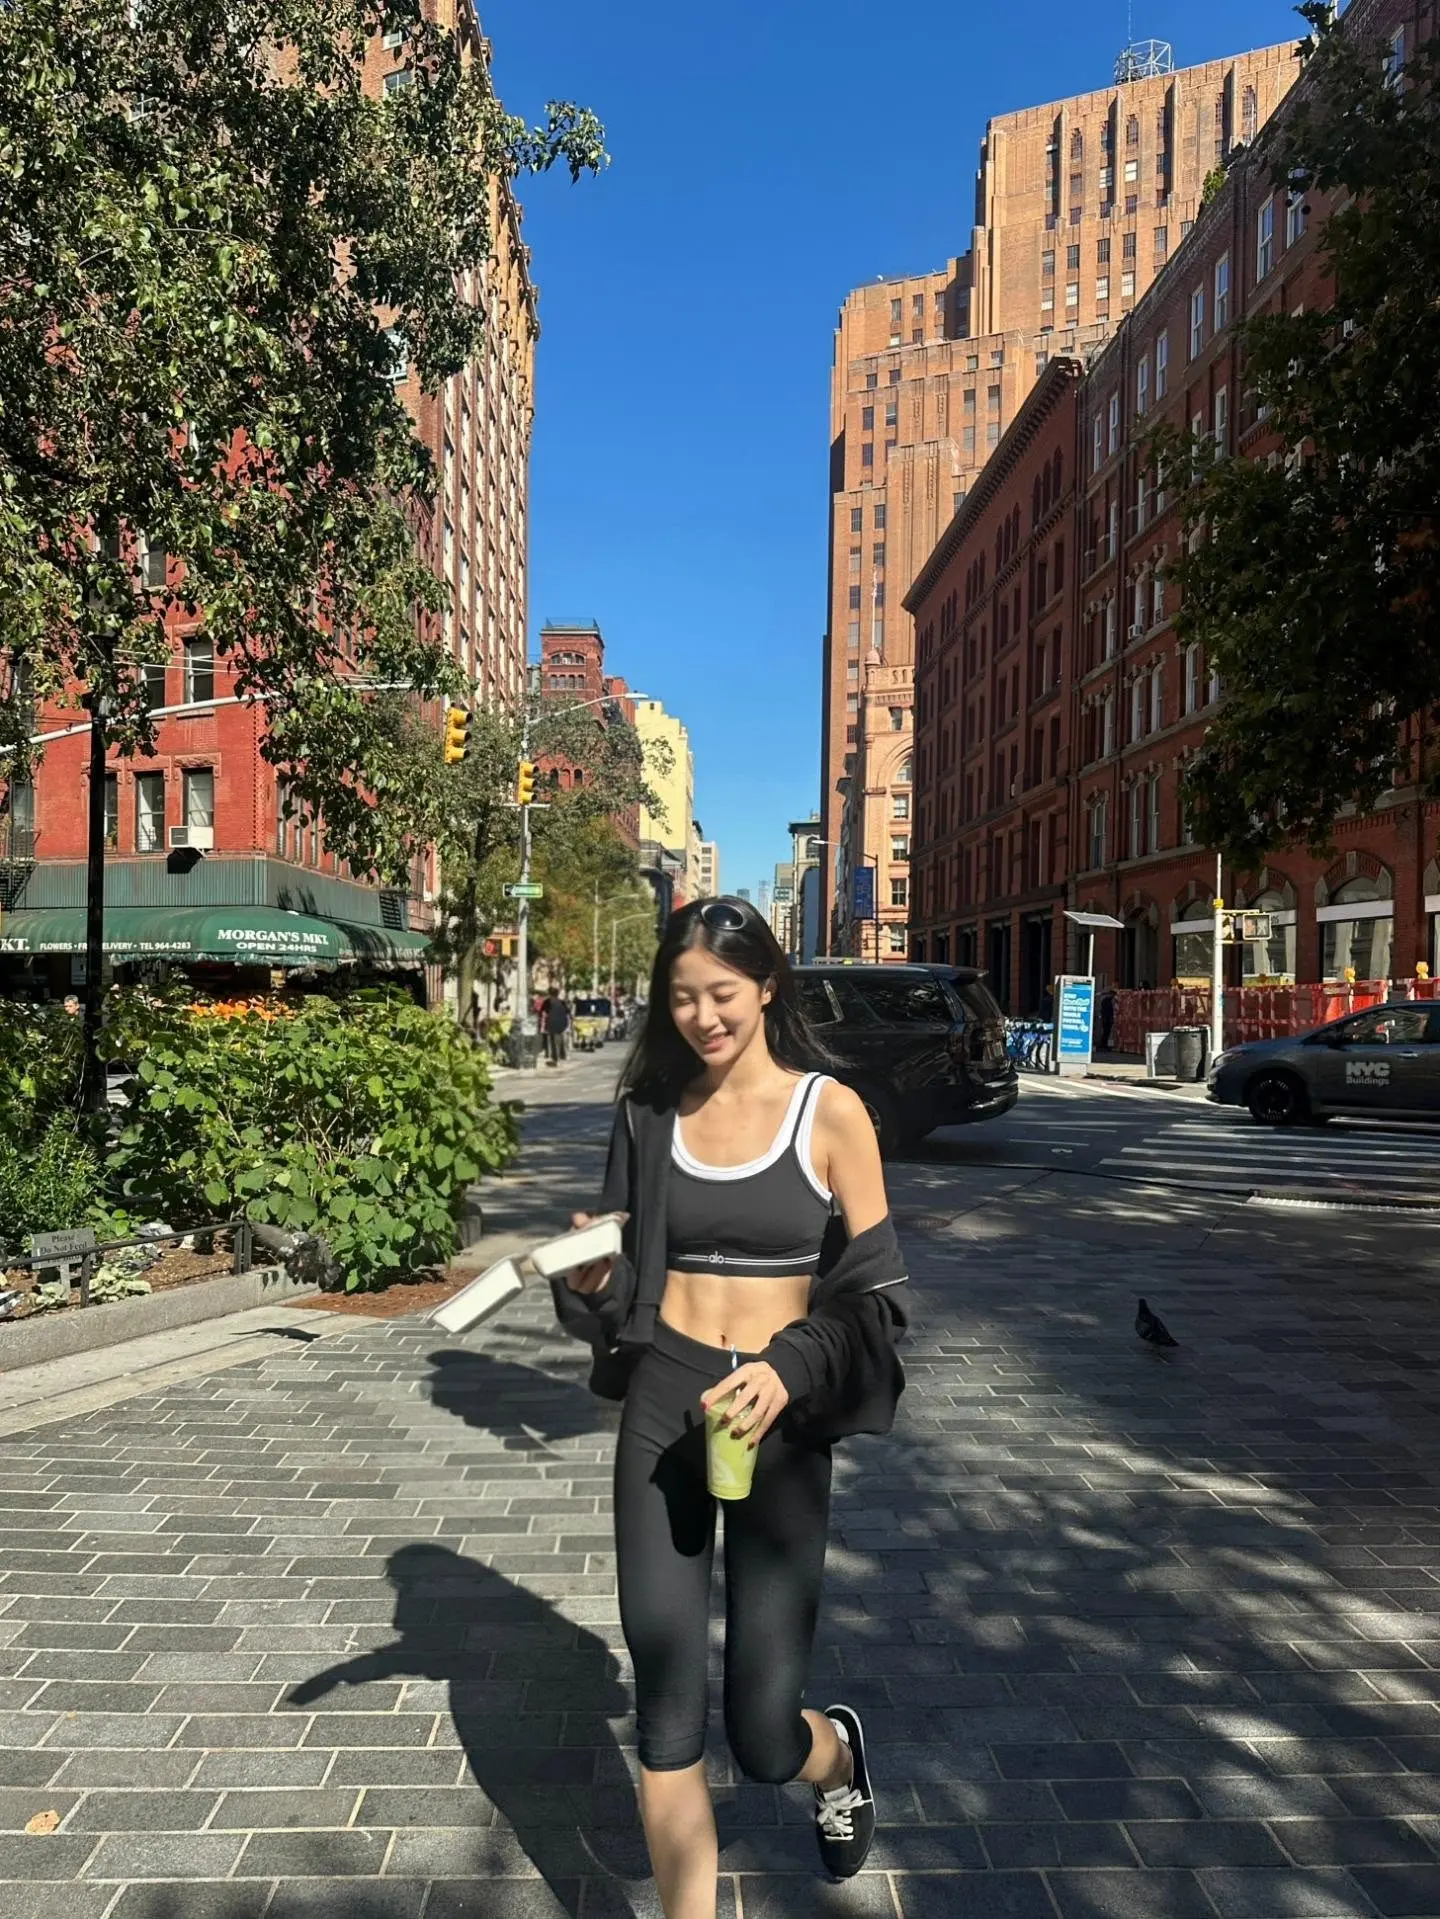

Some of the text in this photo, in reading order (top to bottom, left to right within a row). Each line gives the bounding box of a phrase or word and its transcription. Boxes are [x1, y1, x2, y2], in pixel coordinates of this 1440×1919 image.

[217, 929, 300, 942] MORGAN'S
[0, 938, 30, 951] KT.
[40, 942, 72, 950] FLOWERS
[102, 942, 132, 950] ELIVERY
[140, 942, 154, 950] TEL
[155, 942, 191, 950] 964-4283
[236, 942, 317, 953] OPEN 24HRS
[1346, 1061, 1390, 1076] NYC
[1346, 1076, 1390, 1087] Buildings
[51, 1235, 75, 1243] Please
[709, 1250, 724, 1264] alo
